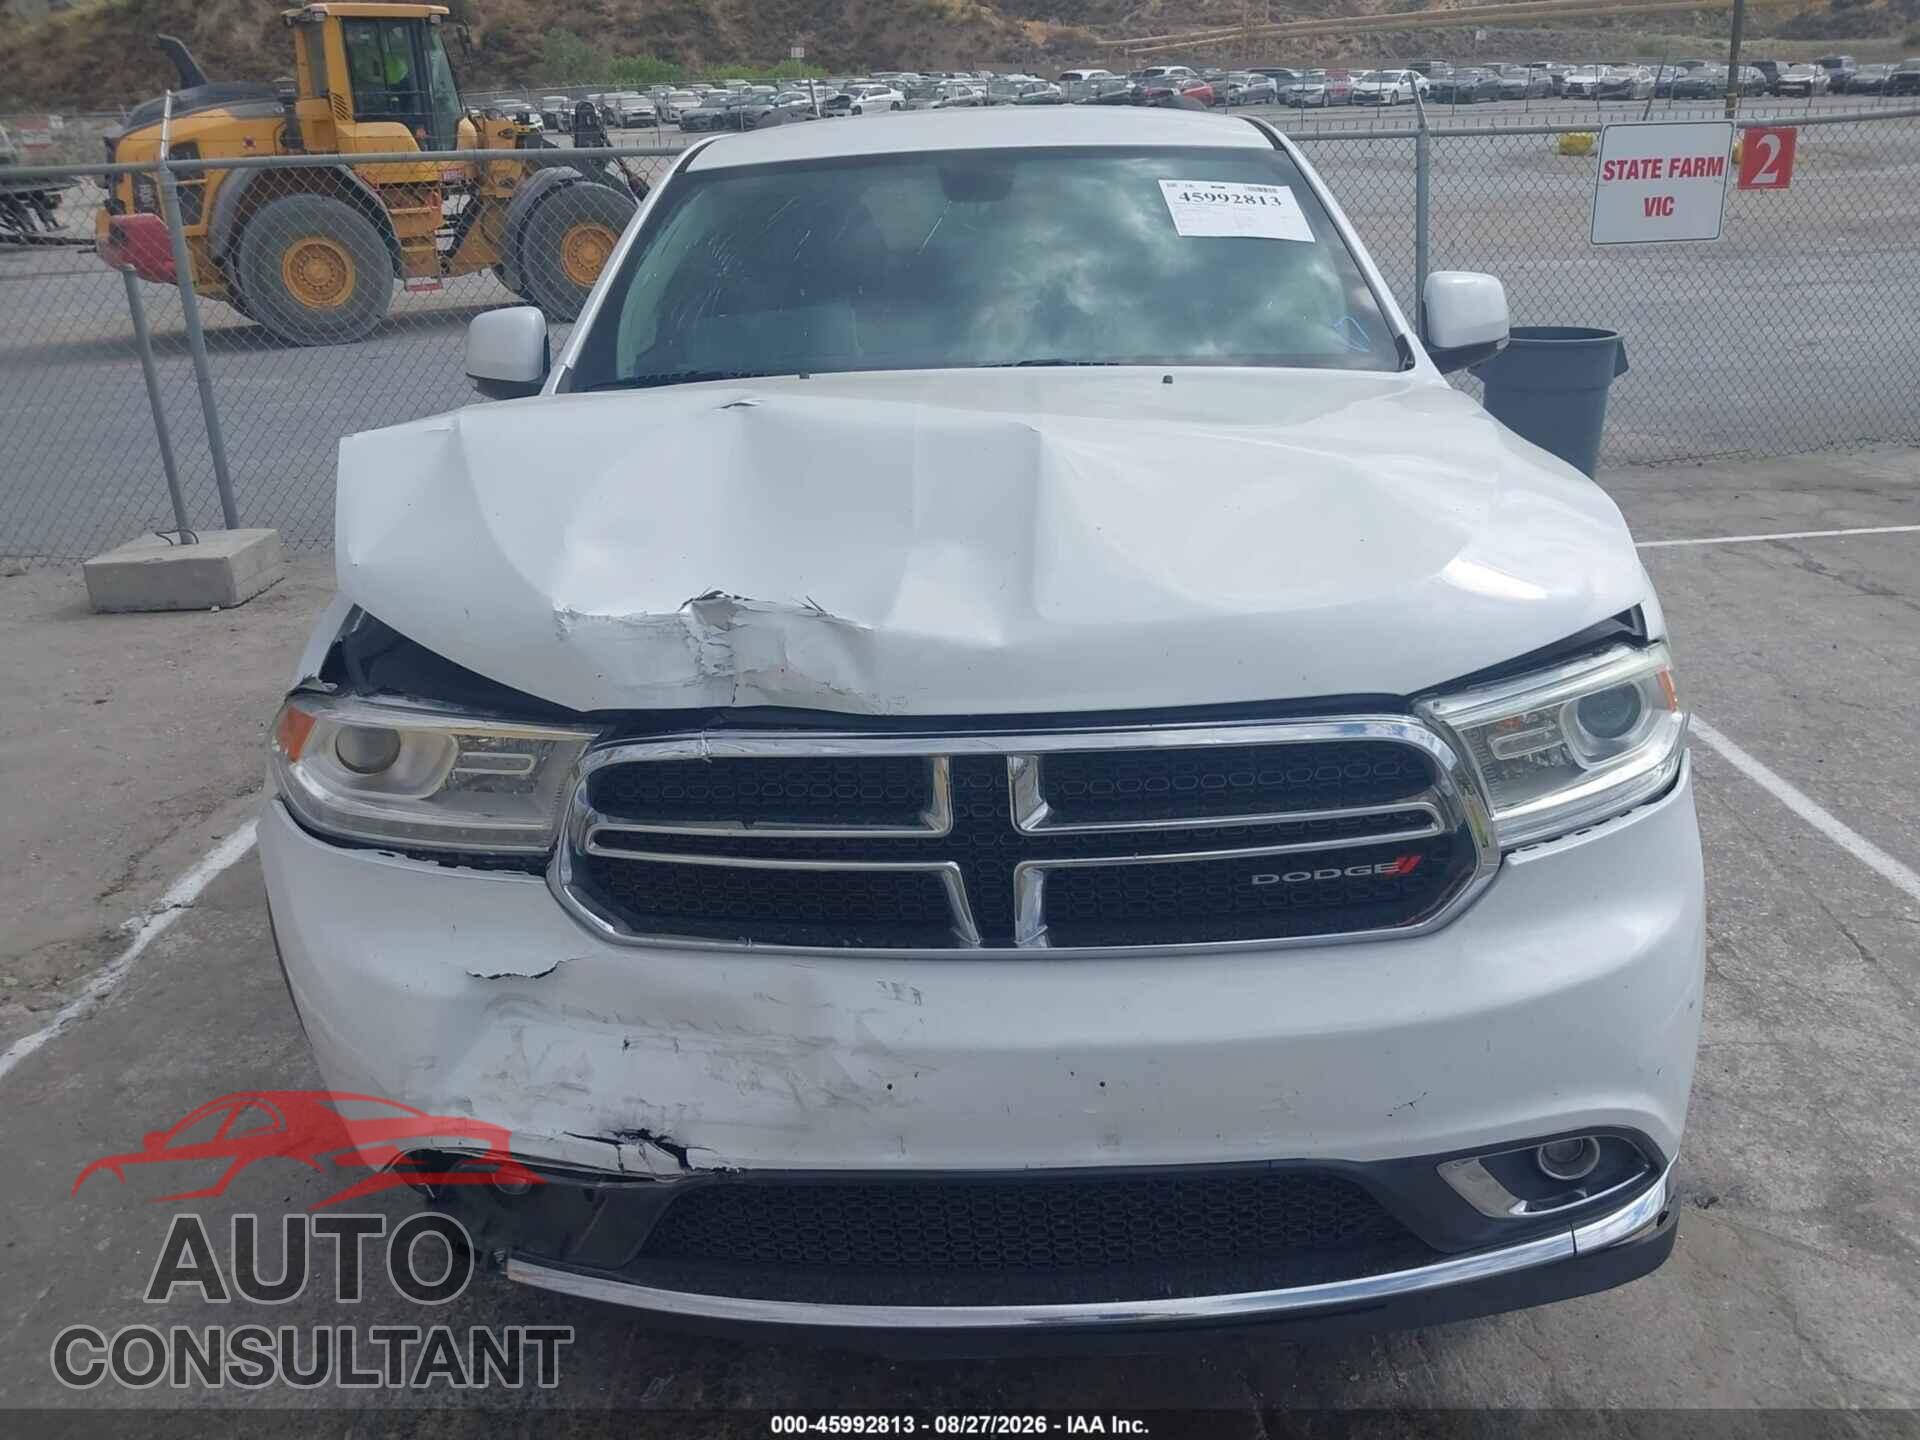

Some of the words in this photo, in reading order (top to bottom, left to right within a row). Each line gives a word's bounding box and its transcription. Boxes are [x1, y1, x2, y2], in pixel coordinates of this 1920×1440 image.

[1602, 158, 1662, 181] STATE
[1668, 156, 1724, 178] FARM
[1751, 134, 1781, 184] 2
[1178, 192, 1282, 207] 45992813
[1643, 196, 1674, 217] VIC
[1252, 861, 1400, 885] DODGE
